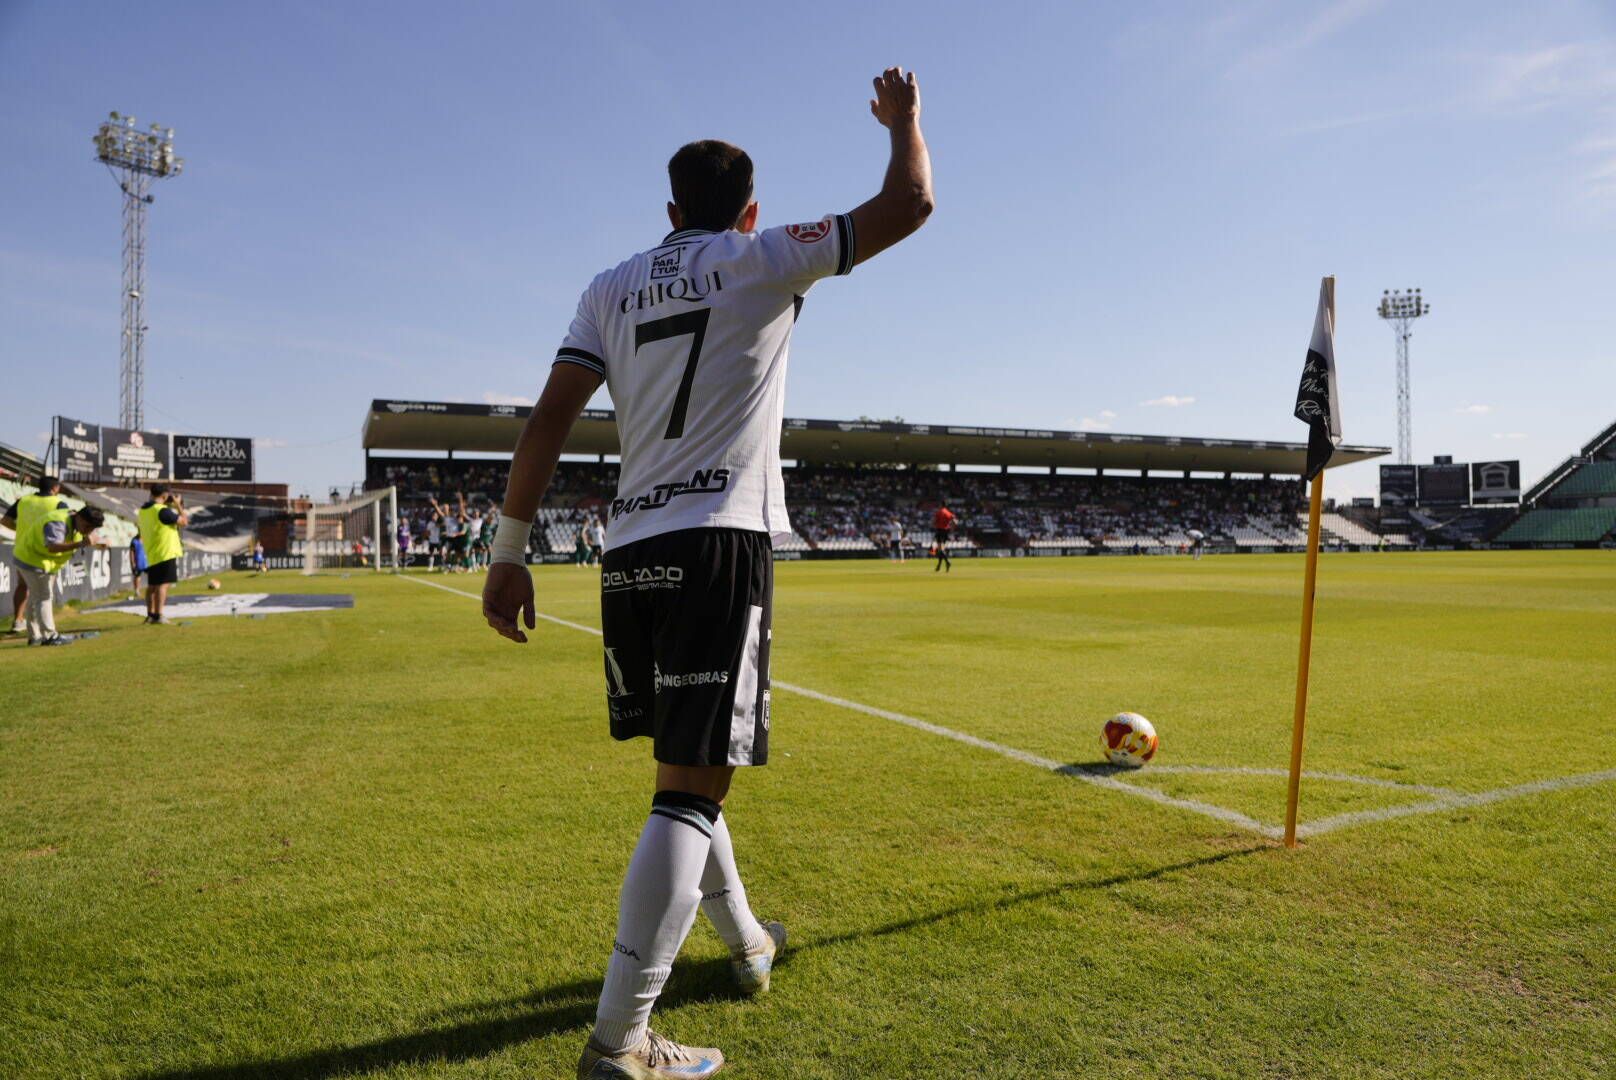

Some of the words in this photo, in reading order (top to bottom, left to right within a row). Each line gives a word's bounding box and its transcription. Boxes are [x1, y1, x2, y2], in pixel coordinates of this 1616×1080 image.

[658, 265, 679, 275] TUN
[620, 270, 723, 314] CHIQUI
[635, 307, 711, 440] 7
[90, 549, 111, 590] GLS
[662, 670, 729, 687] INGEOBRAS
